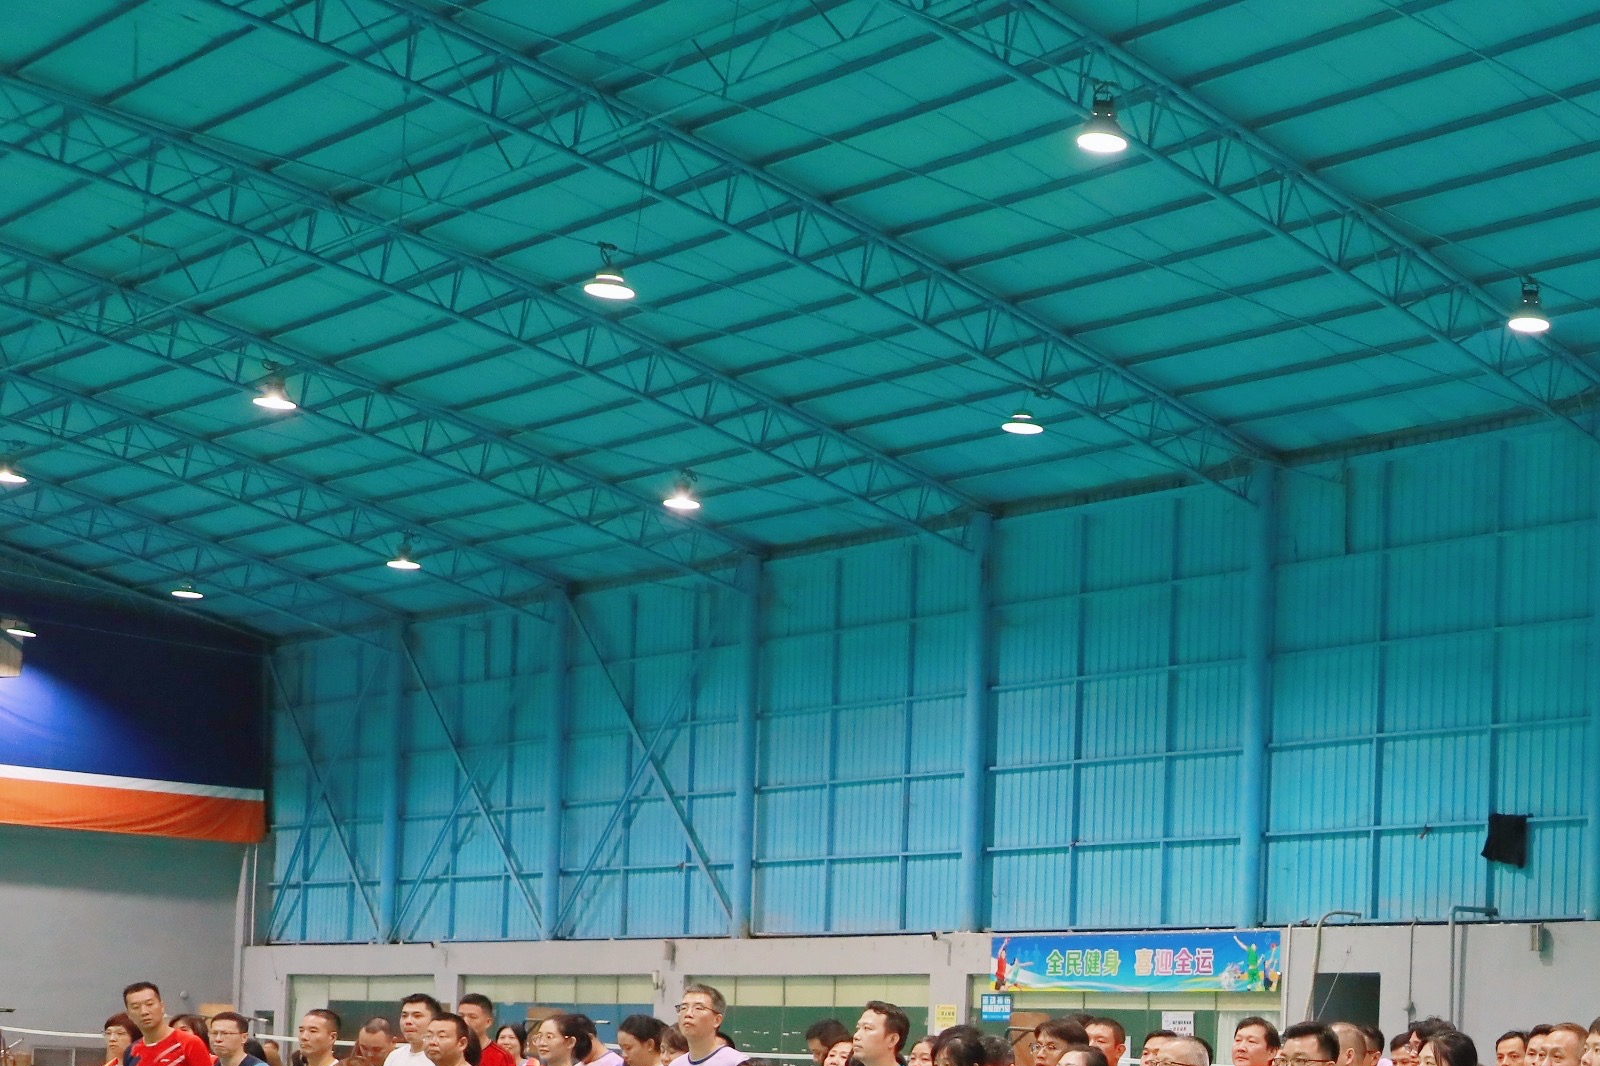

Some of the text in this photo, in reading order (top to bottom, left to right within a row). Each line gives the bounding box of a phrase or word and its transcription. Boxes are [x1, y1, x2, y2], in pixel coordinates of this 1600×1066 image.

[1046, 947, 1215, 977] 全民健身 喜迎全运
